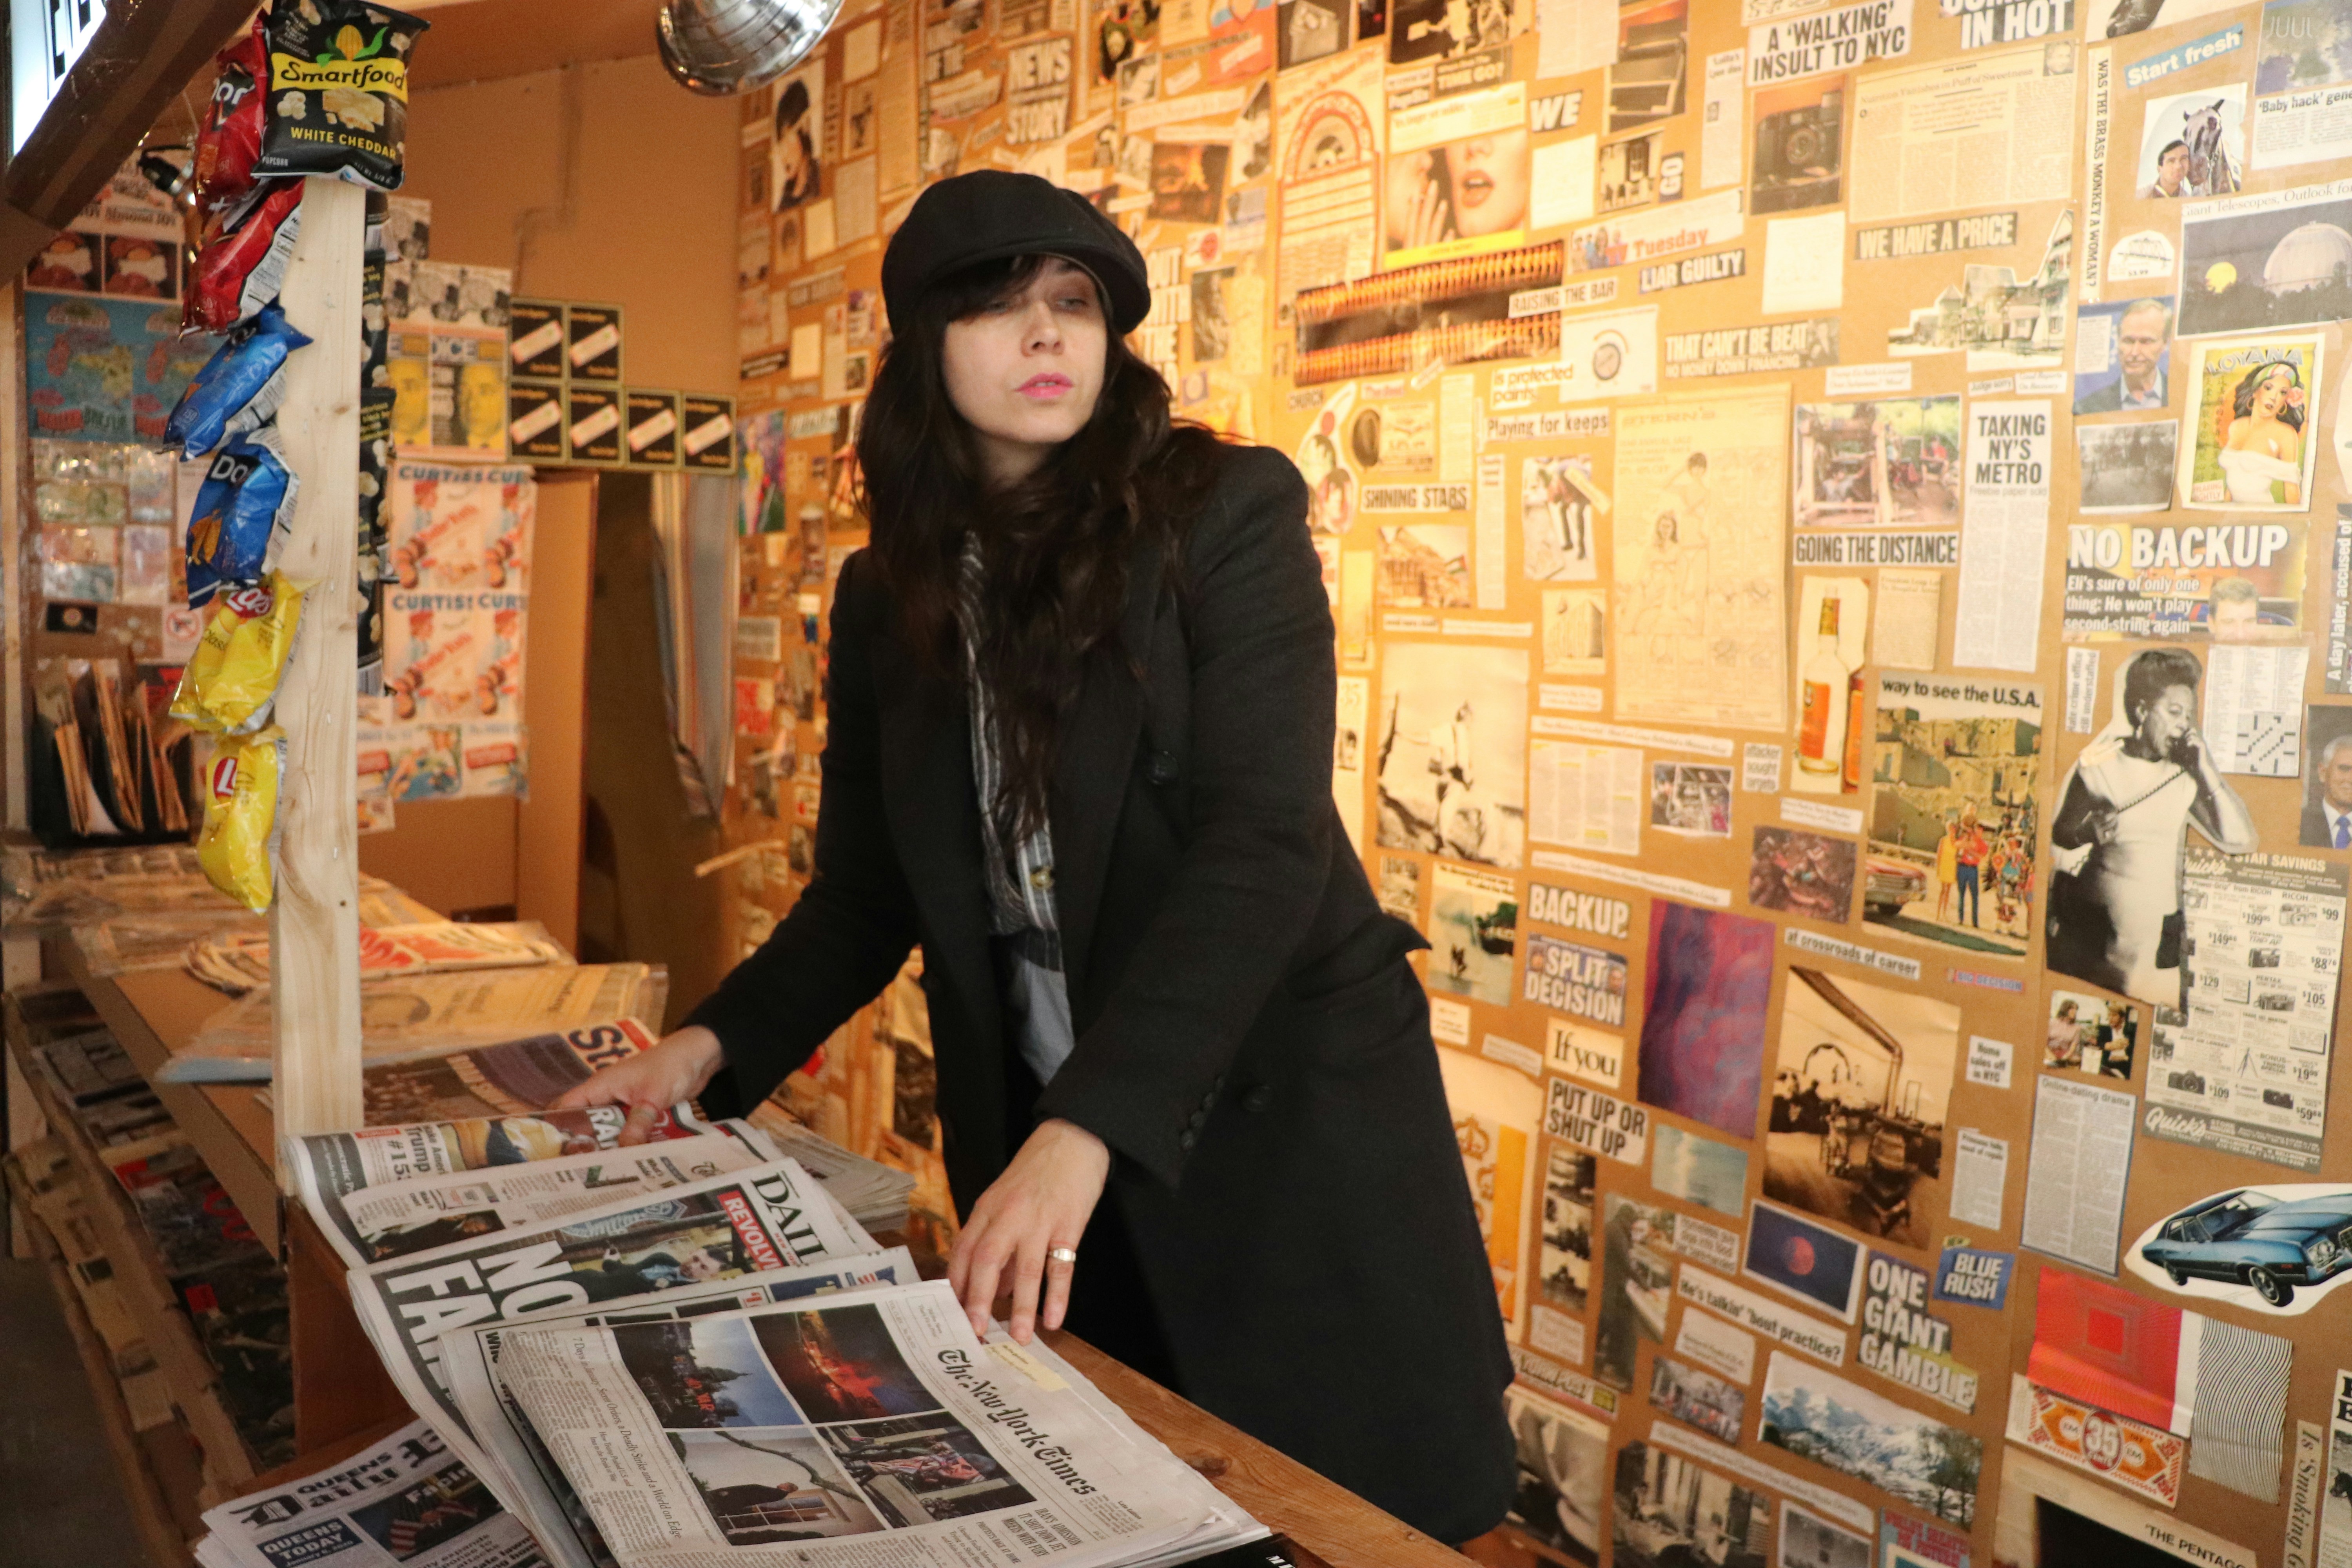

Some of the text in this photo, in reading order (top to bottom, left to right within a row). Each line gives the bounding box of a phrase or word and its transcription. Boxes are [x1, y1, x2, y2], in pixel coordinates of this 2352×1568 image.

[1767, 0, 1894, 52] A 'WALKING'
[1960, 0, 2066, 50] IN HOT
[1753, 25, 1905, 82] INSULT TO NYC
[2128, 32, 2240, 85] Start fresh
[281, 61, 404, 91] Smartfood
[1530, 91, 1583, 132] WE
[2259, 97, 2288, 113] 'Baby
[2291, 92, 2323, 109] hack'
[290, 126, 397, 160] WHITE CHEDDAR
[1659, 156, 1683, 197] GO
[2086, 58, 2109, 288] WAS THE BRASS MONKEY A WOMAN?
[2215, 194, 2281, 216] Telescopes,
[2284, 184, 2334, 203] Outlook
[1633, 226, 1709, 257] Tuesday
[1860, 214, 2015, 258] WE HAVE A PRICE
[1641, 250, 1744, 293] LIAR GUILTY
[1564, 281, 1615, 305] THE BAR
[1666, 321, 1808, 361] THAT CAN'T BE BEAT
[1508, 362, 1573, 387] protected
[2206, 345, 2304, 378] LOYANA
[1488, 412, 1607, 436] Playing for keeps
[1977, 414, 2046, 437] TAKING
[1989, 438, 2031, 461] NY'S
[1976, 462, 2043, 485] METRO
[1796, 535, 1957, 564] GOING THE DISTANCE
[2070, 524, 2289, 568] NO BACKUP
[2067, 575, 2200, 594] Eli's sure of only one
[2336, 537, 2352, 598] accused
[2065, 595, 2193, 615] thing: He won't play
[2331, 602, 2350, 638] later,
[2064, 617, 2190, 637] second-string again
[2329, 640, 2347, 666] day
[2327, 669, 2342, 681] A
[1882, 678, 2040, 708] way to see the U.S.A.
[2271, 855, 2327, 873] SAVINGS
[2282, 891, 2308, 901] RICOH
[2322, 907, 2339, 921] $99
[1544, 946, 1607, 985] SPLIT
[1800, 935, 1862, 960] crossroads
[1864, 951, 1876, 964] of
[1879, 956, 1918, 976] career
[1524, 970, 1624, 1026] DECISION
[2302, 990, 2325, 1005] $105
[1554, 1027, 1615, 1076] If you
[2209, 1084, 2230, 1098] $109
[1552, 1080, 1646, 1137] PUT UP OR
[2145, 1107, 2207, 1136] Quick's
[405, 1126, 431, 1172] Trump
[1548, 1108, 1627, 1158] SHUT UP
[1869, 1257, 1926, 1310] ONE
[1955, 1253, 2005, 1280] BLUE
[1944, 1272, 1998, 1300] RUSH
[1864, 1296, 1949, 1355] GIANT
[1859, 1333, 1975, 1405] GAMBLE
[938, 1348, 974, 1388] The
[986, 1408, 1046, 1452] York
[1034, 1446, 1096, 1495] Times
[2086, 1416, 2118, 1457] 35
[574, 1343, 586, 1360] Days
[621, 1430, 638, 1451] Deadly
[632, 1452, 648, 1471] Strike
[642, 1471, 657, 1483] and
[652, 1489, 671, 1509] World
[668, 1519, 682, 1539] Edge
[297, 1453, 393, 1494] QUEENS
[2287, 1430, 2320, 1549] Is 'Smoking
[264, 1522, 343, 1555] QUEENS
[279, 1533, 347, 1561] TODAY
[1001, 1518, 1050, 1557] MEETS WITH FURY
[1024, 1517, 1044, 1530] SHOT
[1036, 1529, 1058, 1543] DOWN
[1049, 1541, 1067, 1552] JET
[1051, 1523, 1082, 1546] ADMISSION
[1005, 1551, 1021, 1564] HOME
